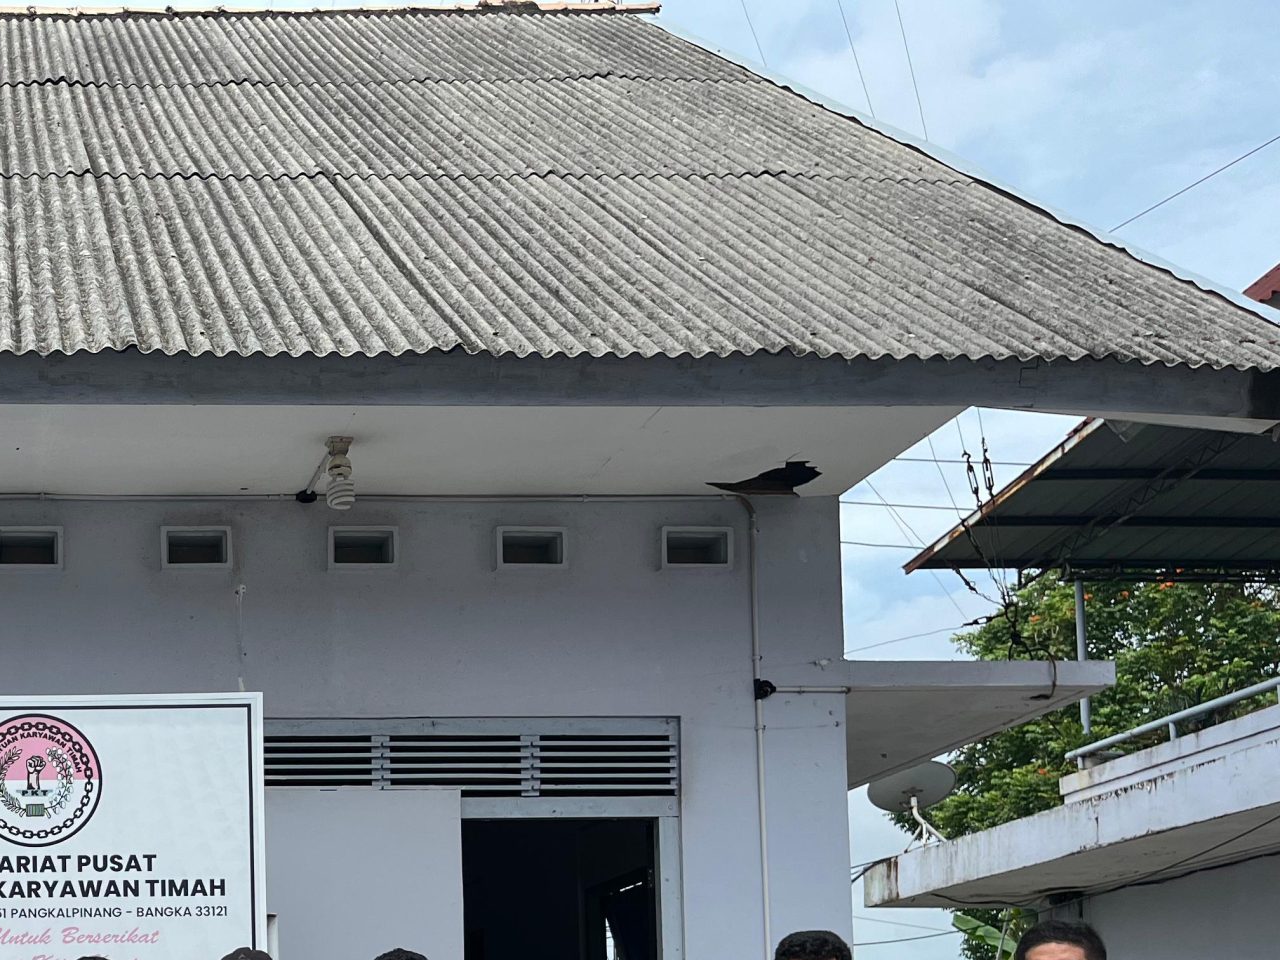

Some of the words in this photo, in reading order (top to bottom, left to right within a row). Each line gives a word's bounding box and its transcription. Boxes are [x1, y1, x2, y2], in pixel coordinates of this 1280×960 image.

[20, 731, 67, 749] KARYAWAN
[66, 746, 82, 773] TIMAH
[77, 854, 157, 873] PUSAT
[145, 878, 226, 897] TIMAH
[10, 907, 122, 919] PANGKALPINANG
[136, 906, 192, 918] BANGKA
[195, 905, 228, 917] 33121
[61, 926, 160, 945] Berserikat
